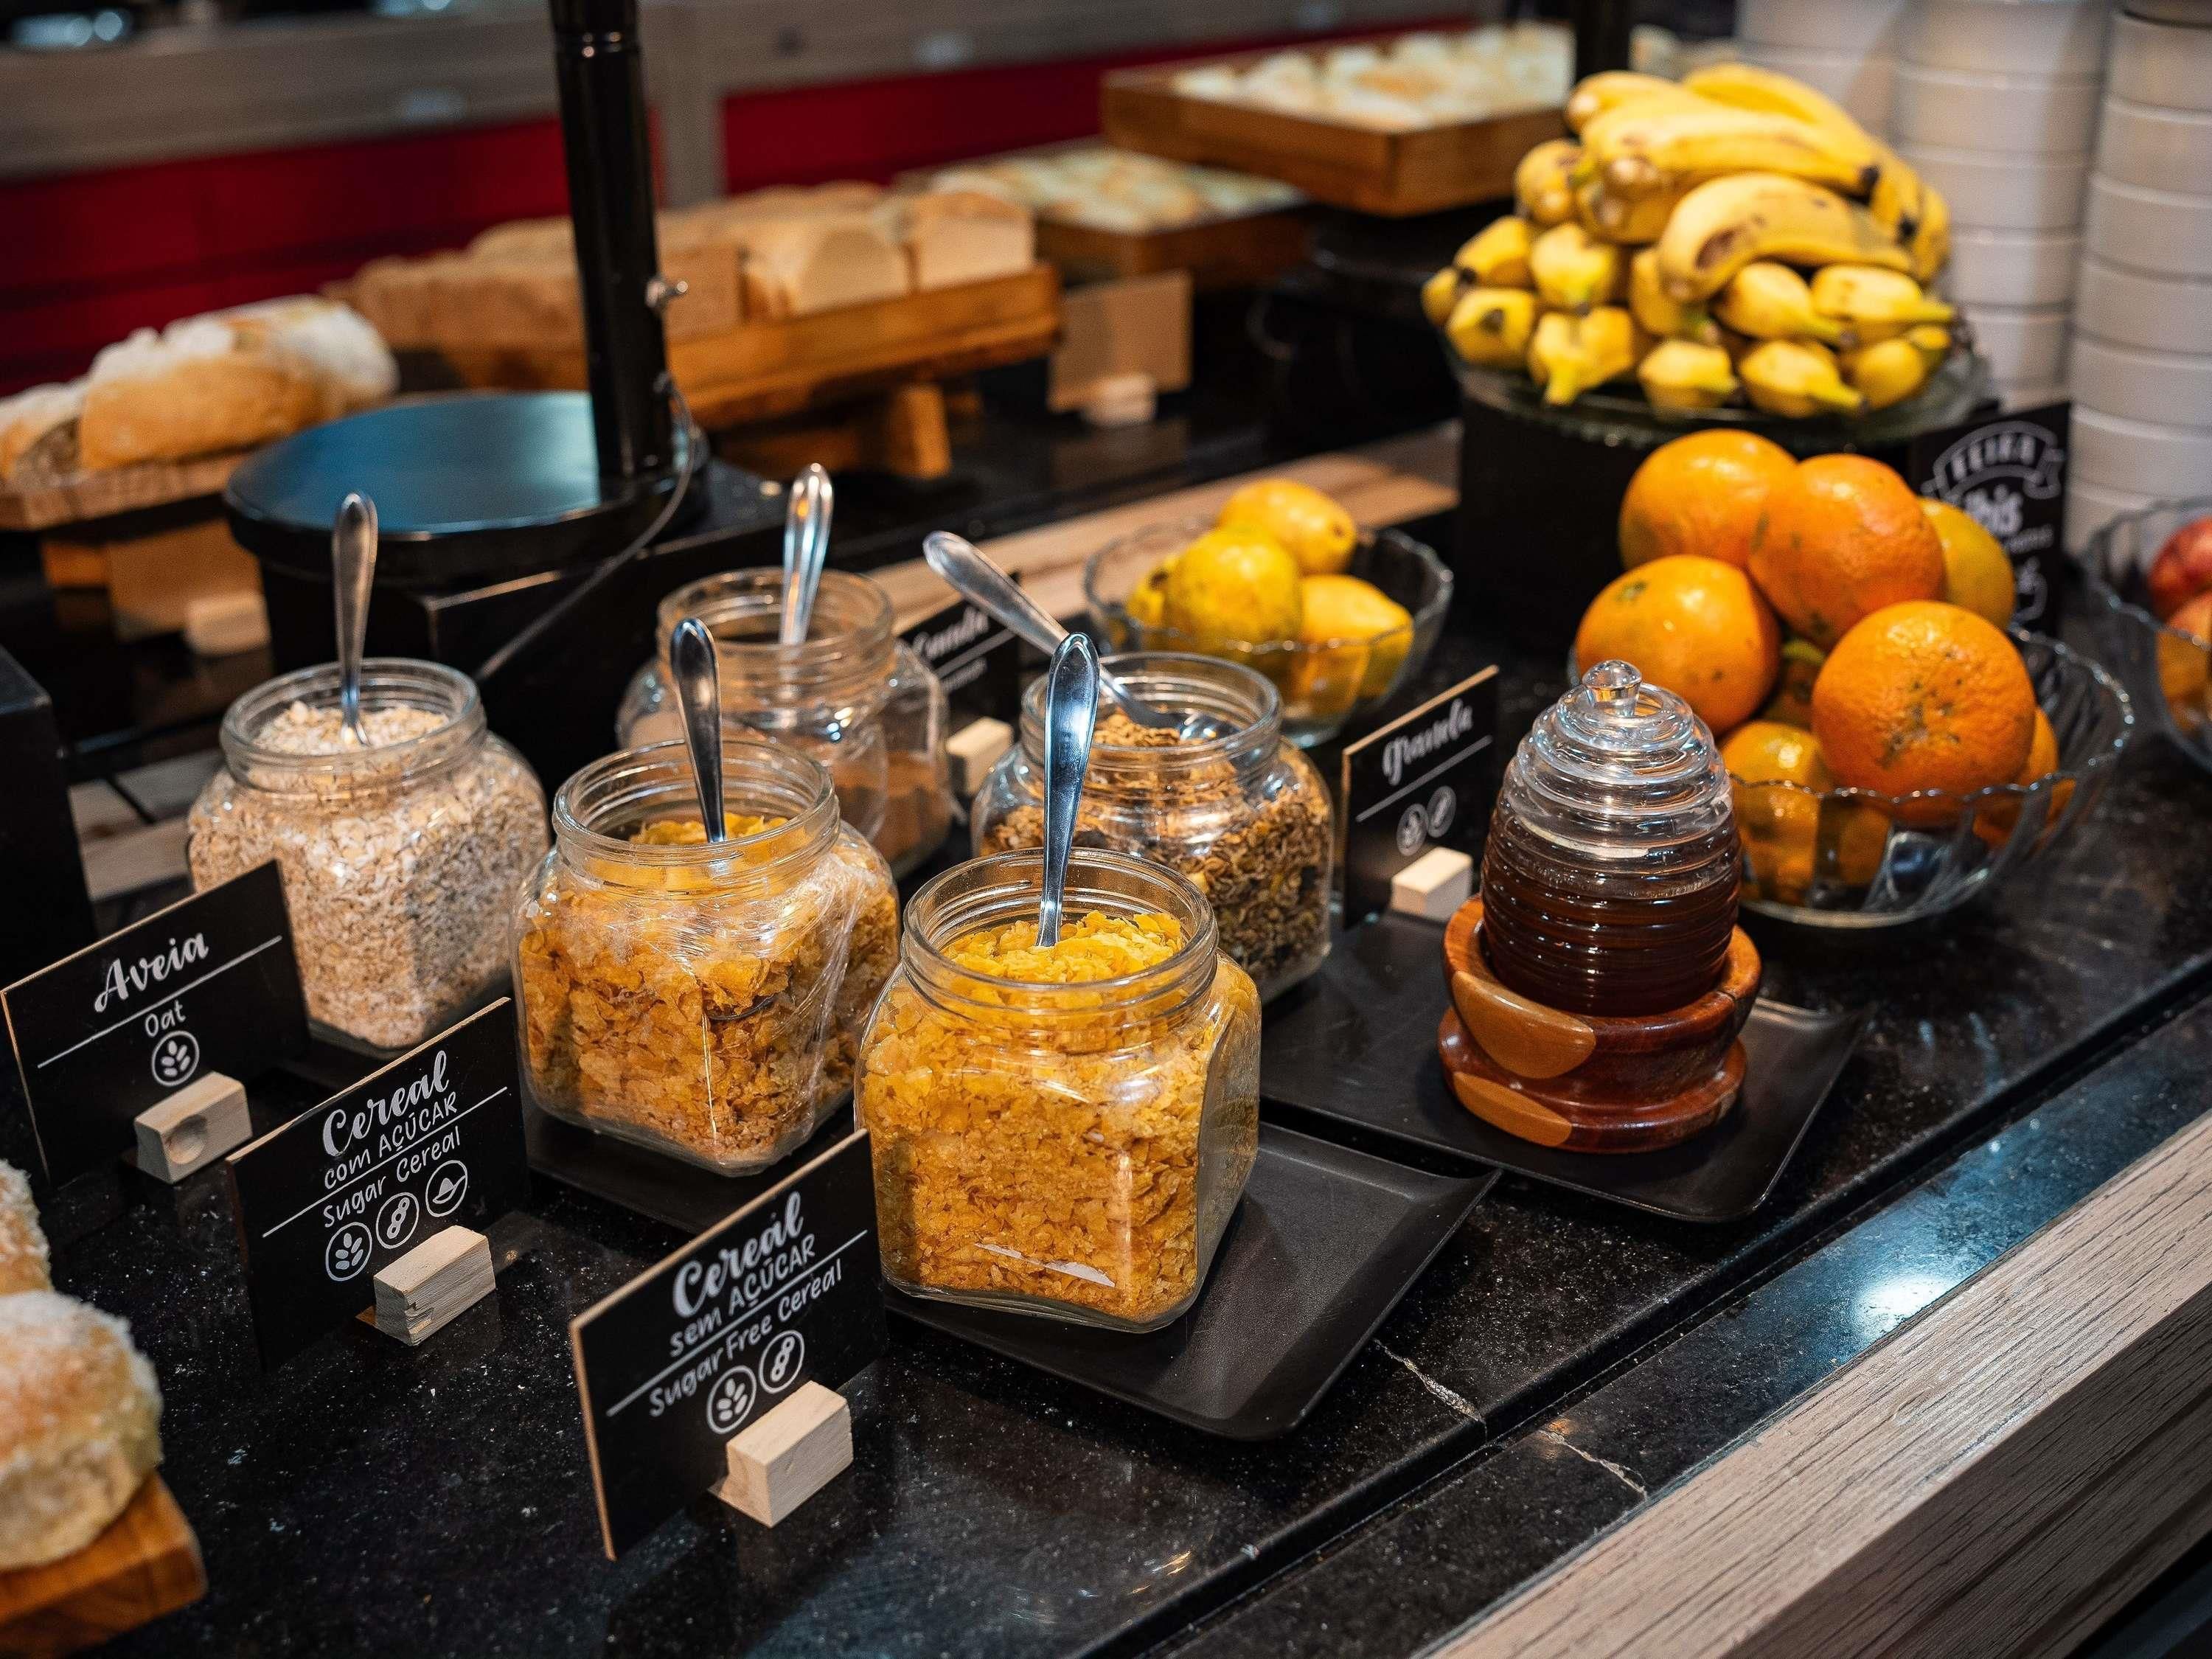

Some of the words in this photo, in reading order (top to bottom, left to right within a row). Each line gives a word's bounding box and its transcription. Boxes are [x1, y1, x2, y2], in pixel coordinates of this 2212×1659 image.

[94, 933, 209, 1012] Aveia
[145, 1001, 187, 1037] Oat
[322, 1050, 450, 1157] Cereal
[324, 1147, 372, 1189] com
[378, 1092, 458, 1158] AÇÚCAR
[323, 1176, 386, 1228] Sugar
[396, 1126, 460, 1183] Cereal
[669, 1307, 722, 1357] sem
[728, 1234, 815, 1316] AÇÚCAR
[672, 1191, 805, 1318] Cereal
[649, 1347, 723, 1417] Sugar
[726, 1315, 773, 1360] Free
[778, 1259, 842, 1322] Cereal
